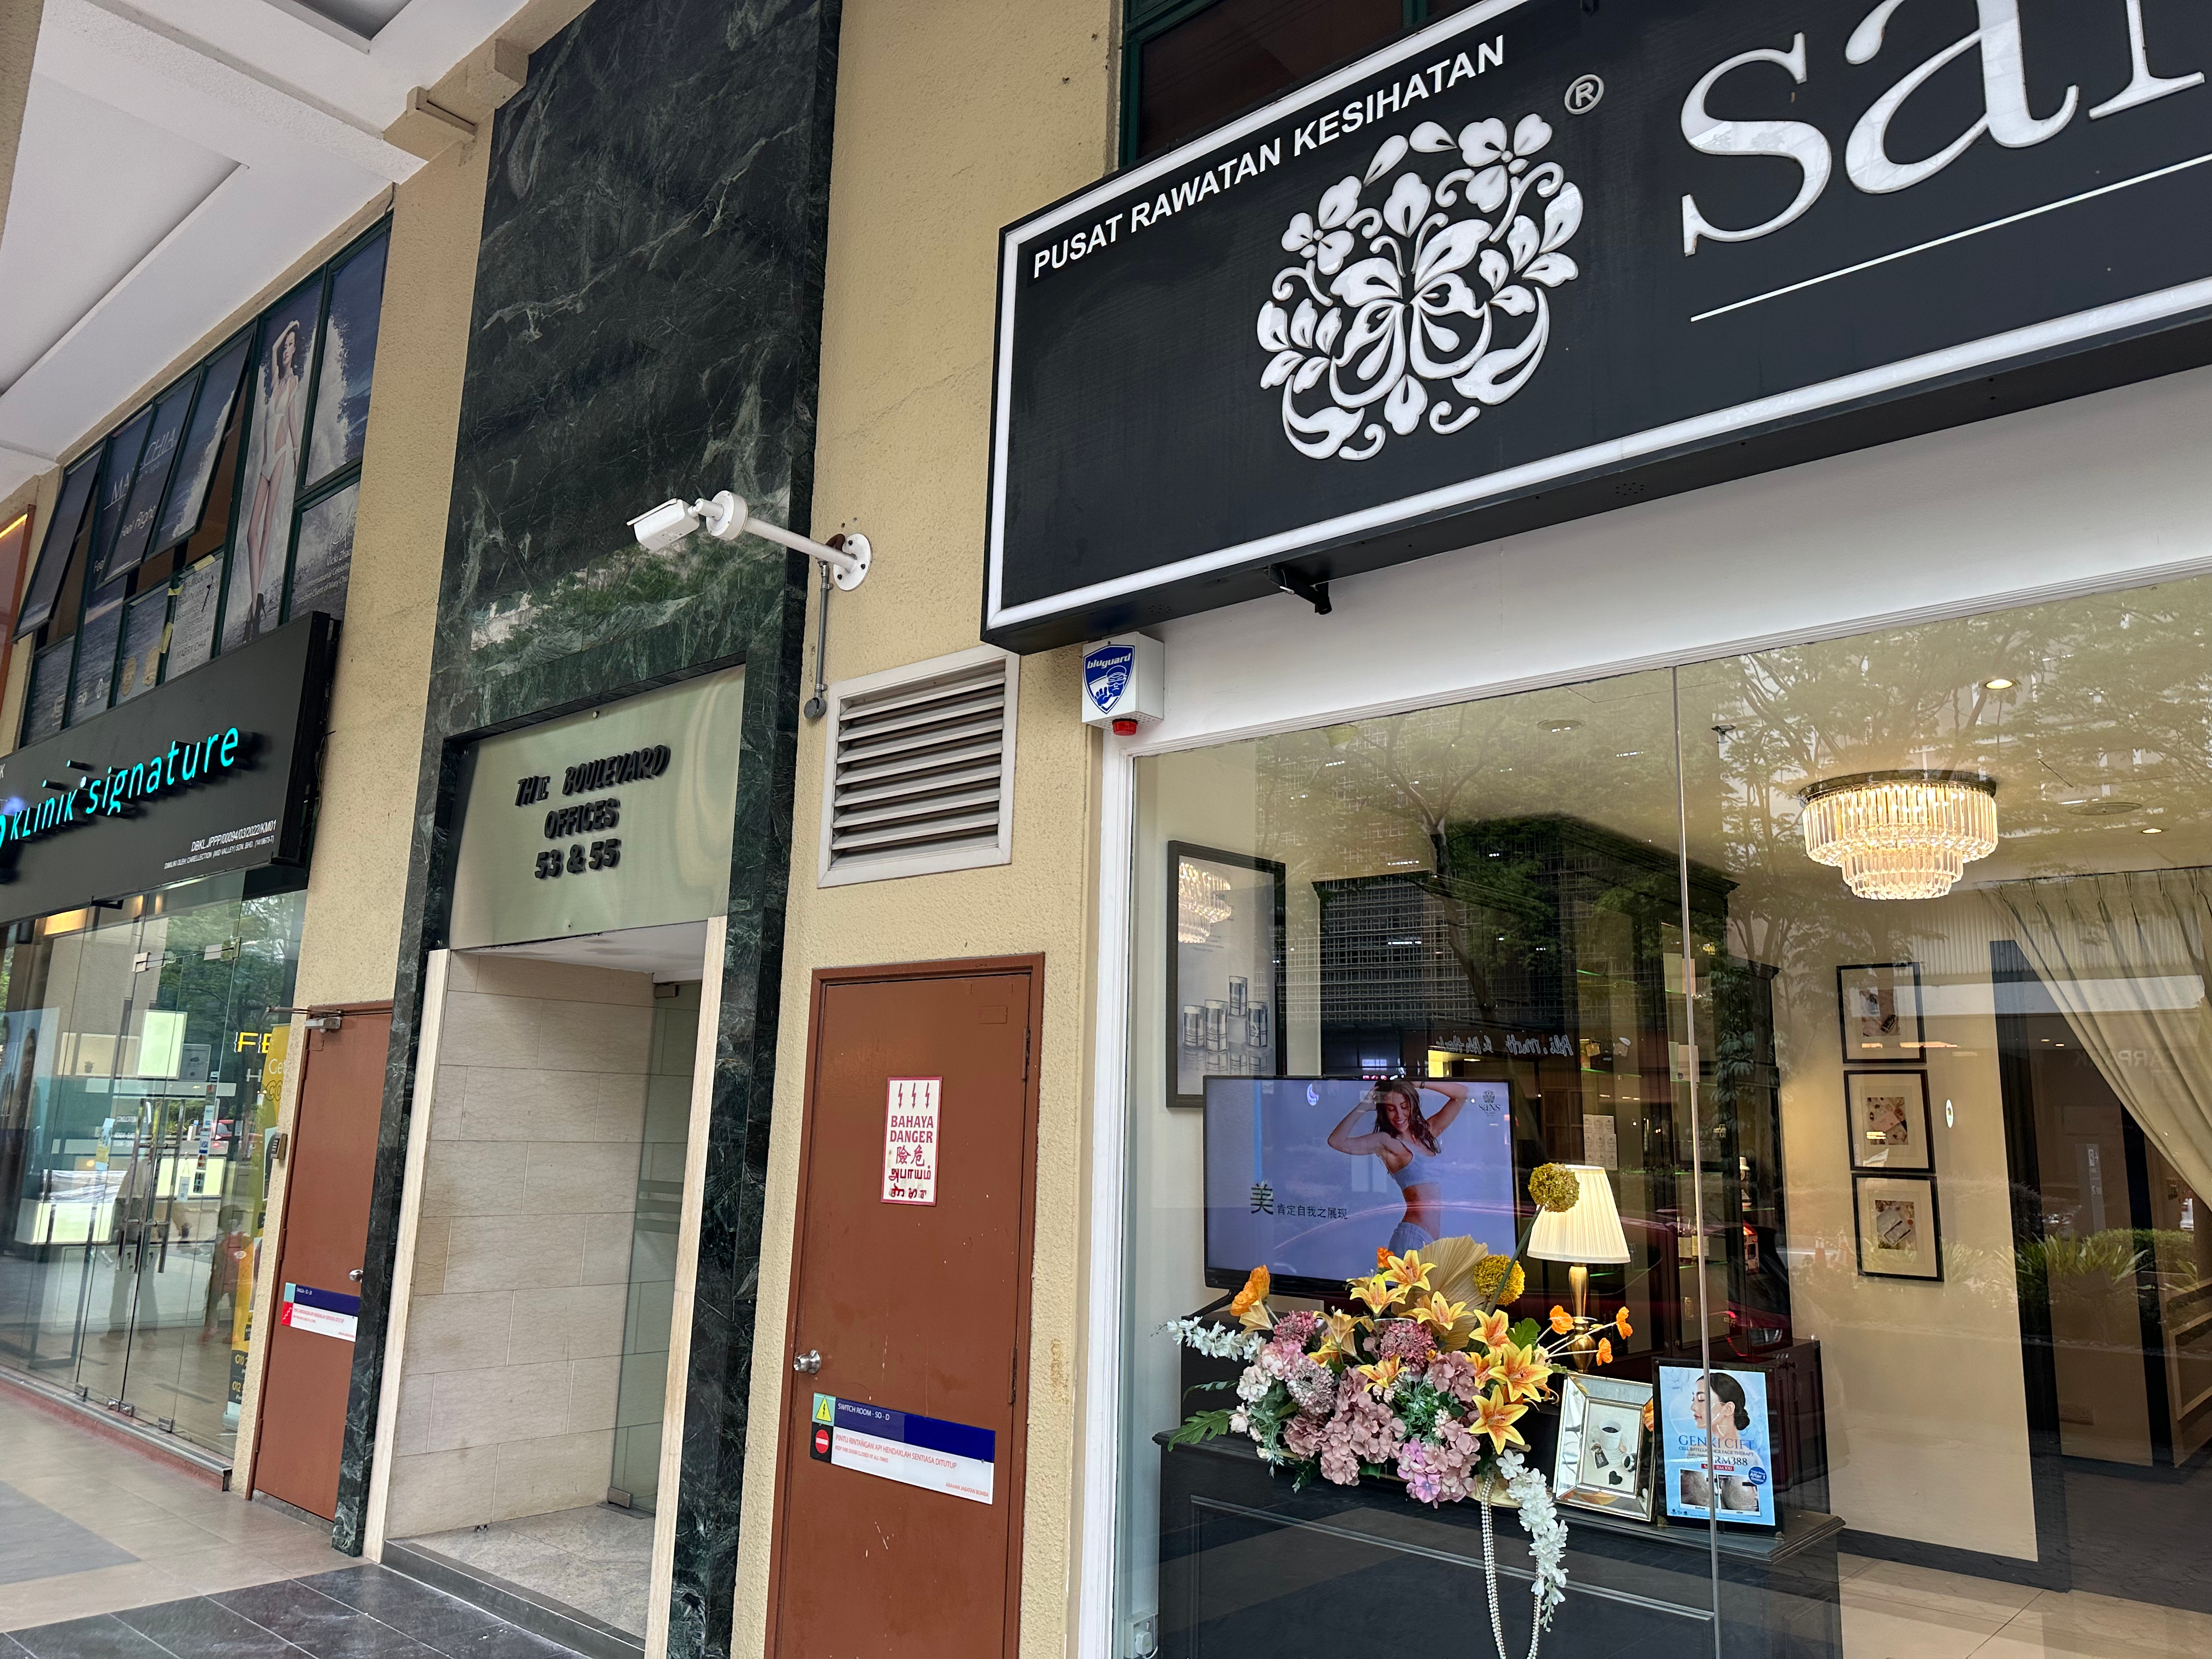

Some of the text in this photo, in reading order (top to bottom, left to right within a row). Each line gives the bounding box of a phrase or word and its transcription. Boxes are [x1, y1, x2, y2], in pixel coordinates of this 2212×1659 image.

[1034, 35, 1505, 279] PUSAT RAWATAN KESIHATAN
[1087, 653, 1132, 669] bluguard
[515, 744, 672, 807] THE BOULEVARD
[544, 798, 620, 839] OFFICES
[534, 838, 622, 879] 53 & 55
[889, 1130, 933, 1143] DANGER
[890, 1115, 934, 1128] BAHAYA
[1250, 1183, 1348, 1220] 美 肯定自我之展现
[837, 1403, 856, 1413] SWITCH
[856, 1407, 872, 1417] ROOM
[874, 1411, 882, 1419] SO
[836, 1434, 849, 1443] PINTU
[849, 1437, 874, 1450] RINTANGAN
[883, 1445, 911, 1459] HENDAKLAH
[912, 1452, 935, 1465] SENTIASA
[935, 1458, 957, 1469] DITUTUP
[1714, 1455, 1748, 1466] RM388
